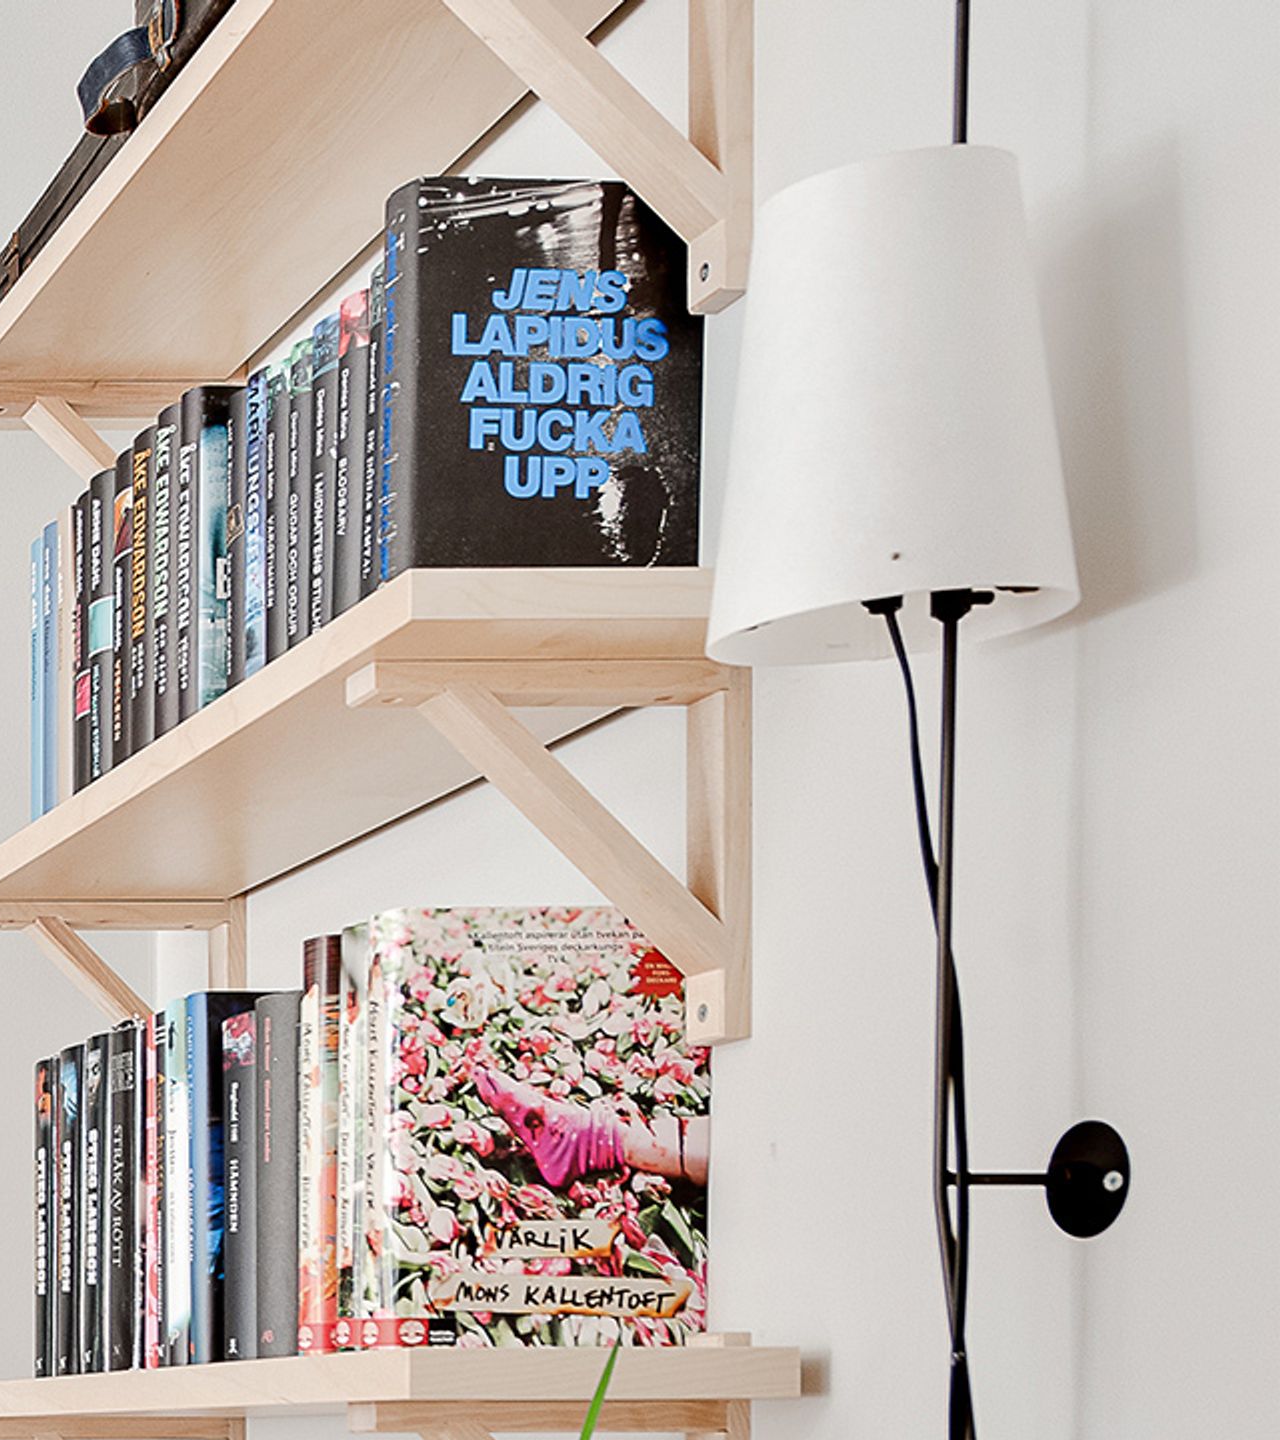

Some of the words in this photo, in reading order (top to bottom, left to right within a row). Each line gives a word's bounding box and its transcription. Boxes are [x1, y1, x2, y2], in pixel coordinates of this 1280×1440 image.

[491, 267, 628, 313] JENS
[451, 313, 669, 362] LAPIDUS
[459, 361, 655, 408] ALDRIG
[156, 423, 178, 473] ÅKE
[468, 407, 647, 453] FUCKA
[133, 447, 154, 496] ÅKE
[503, 455, 611, 499] UPP
[131, 496, 148, 641] EDWARDSON
[153, 473, 171, 621] EDWARDSON
[85, 1191, 98, 1286] LARSSON
[455, 1281, 510, 1303] MONS
[523, 1284, 676, 1313] KALLENTOFT
